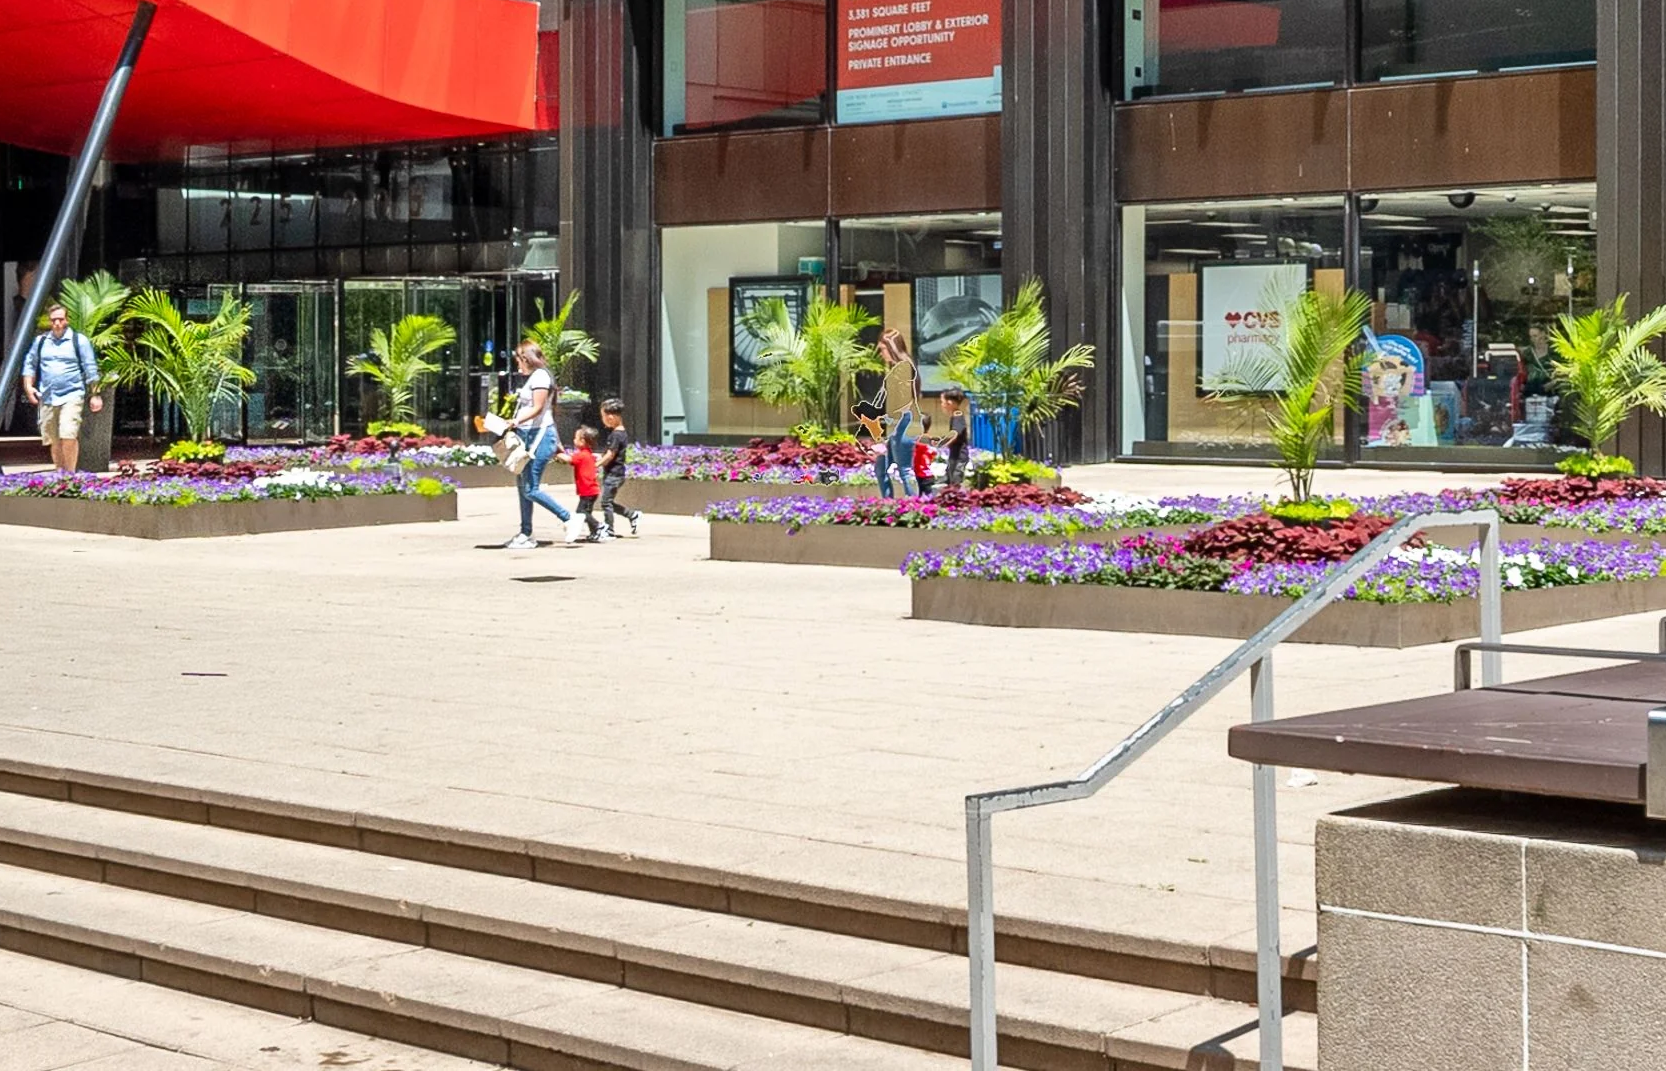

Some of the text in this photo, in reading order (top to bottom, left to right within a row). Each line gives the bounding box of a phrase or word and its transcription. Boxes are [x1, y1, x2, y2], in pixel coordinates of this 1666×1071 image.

[872, 3, 909, 18] SQUARE
[911, 1, 931, 13] FEET
[848, 14, 990, 39] PROMINENT LOBBY & EXTERIOR
[848, 31, 955, 52] SIGNAGE OPPORTUNITY
[848, 52, 932, 71] PRIVATE ENTRANCE
[1243, 310, 1279, 329] CVS
